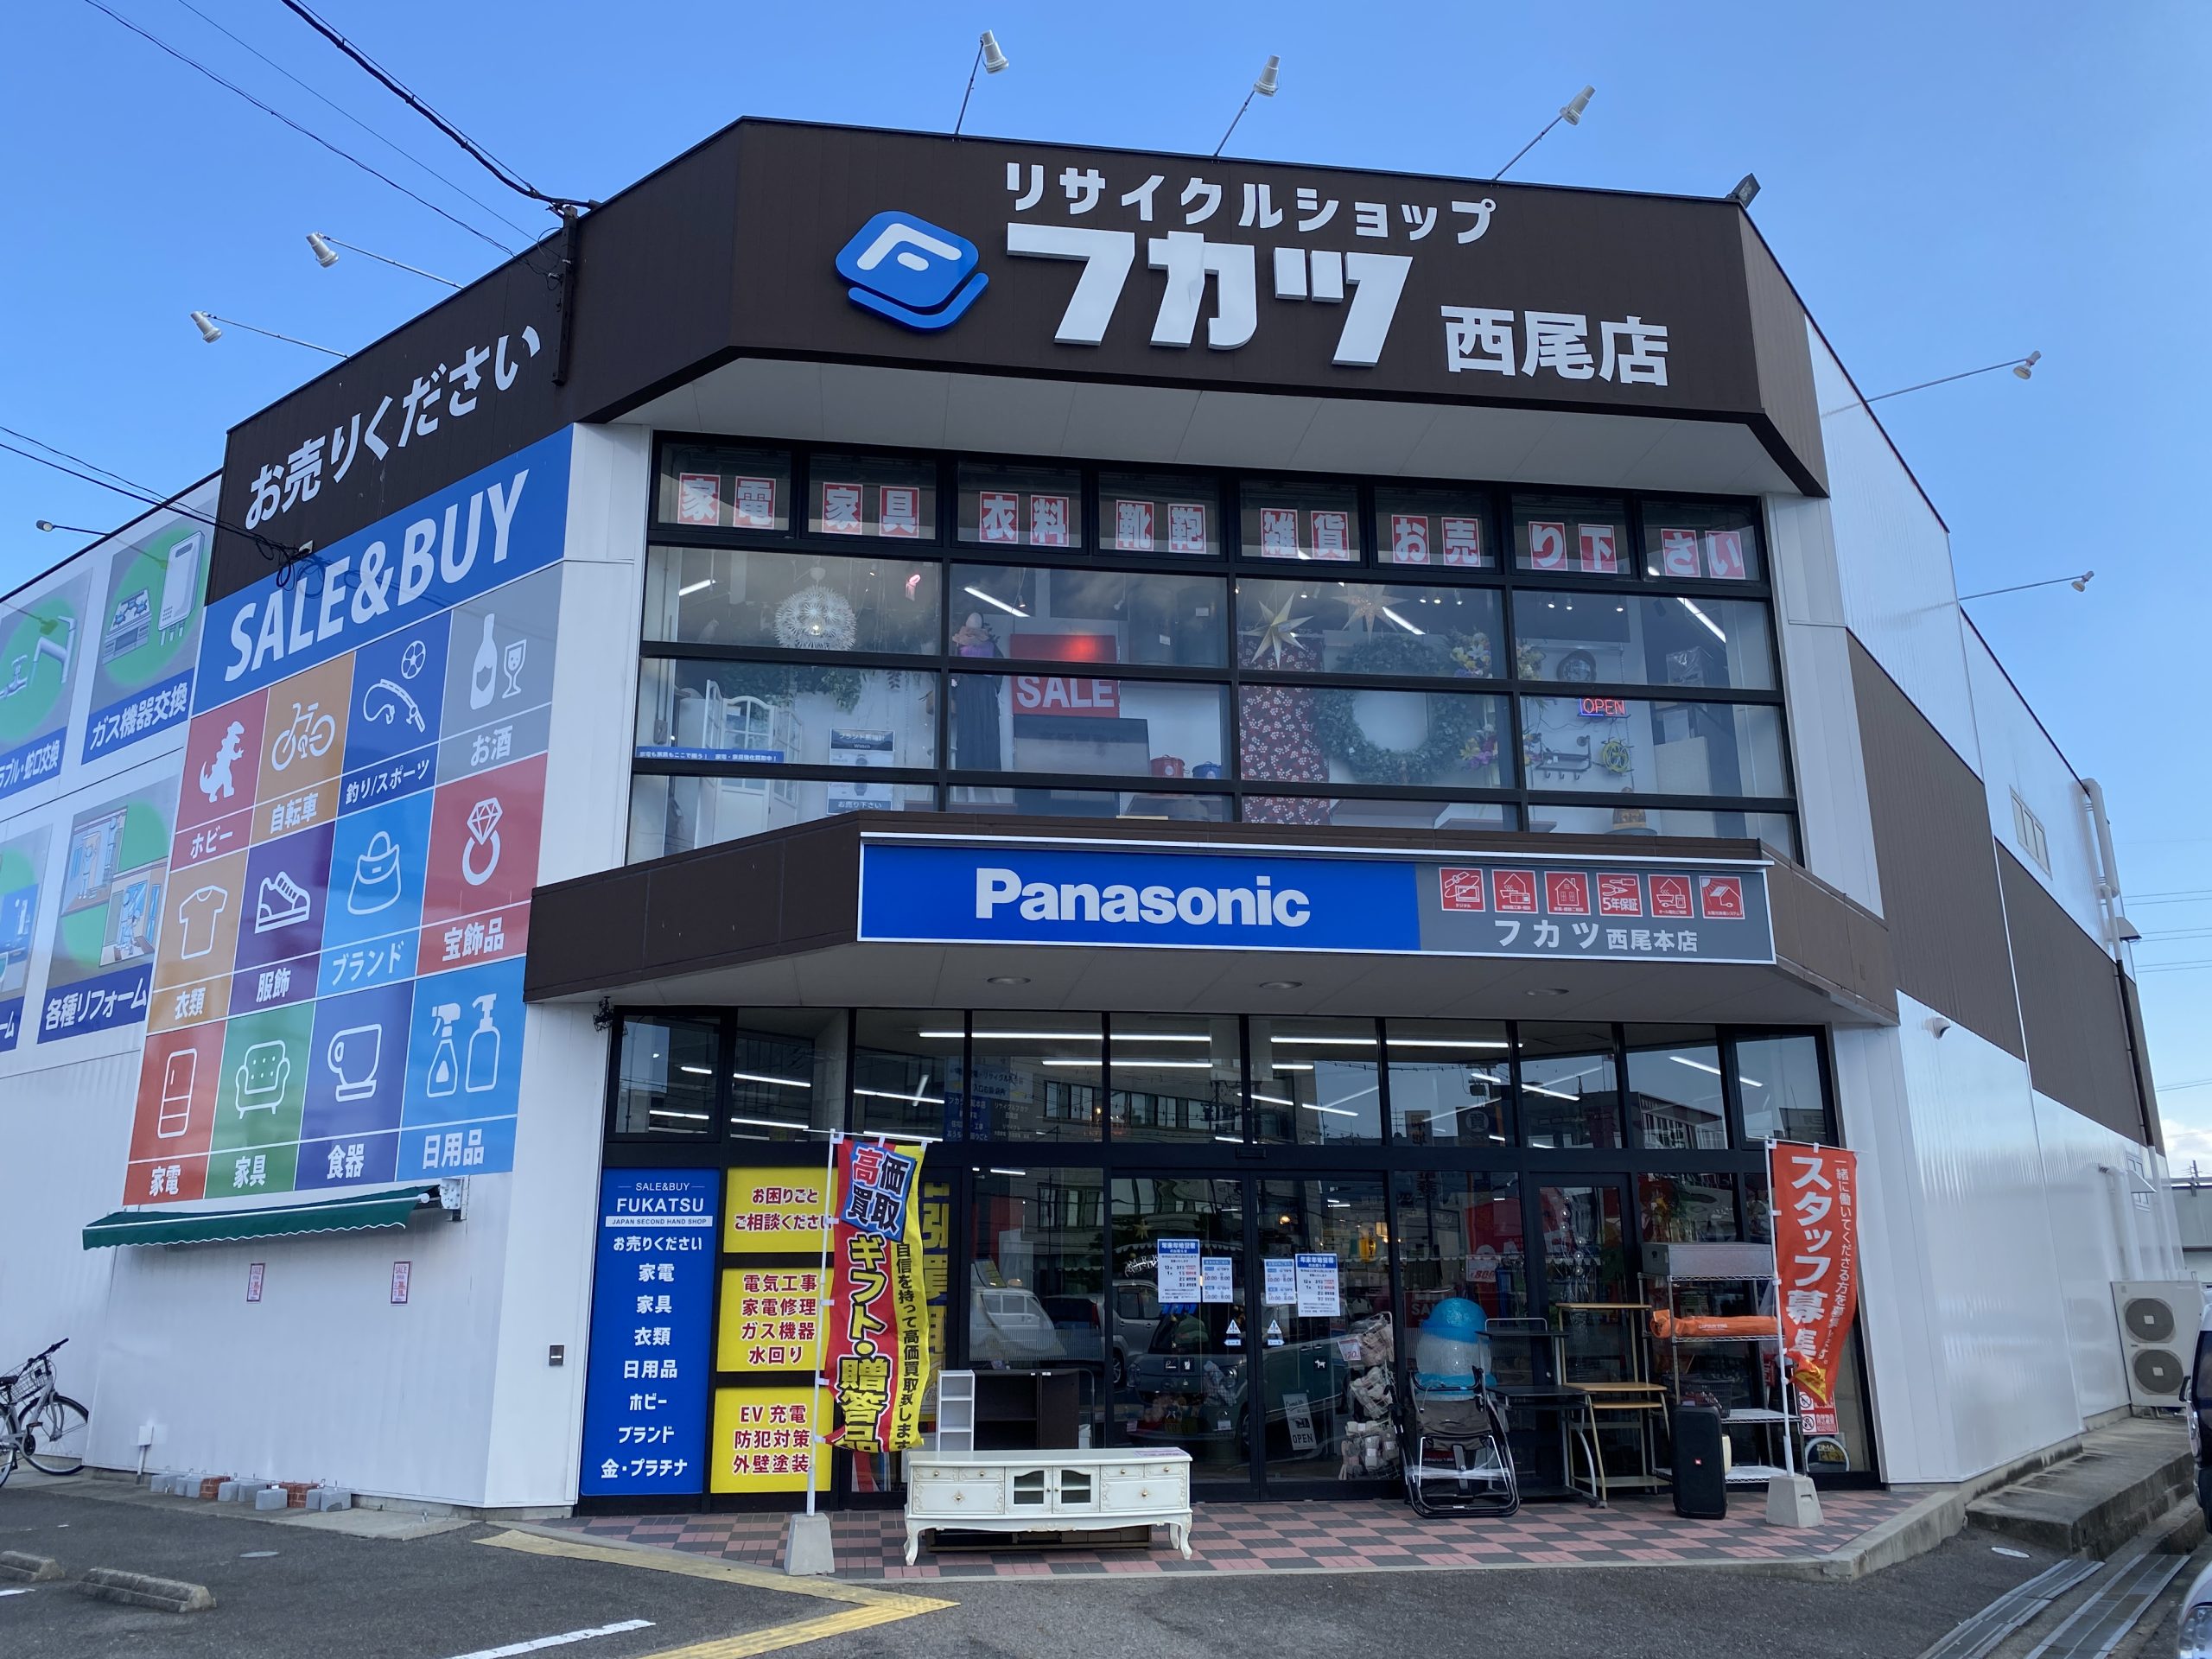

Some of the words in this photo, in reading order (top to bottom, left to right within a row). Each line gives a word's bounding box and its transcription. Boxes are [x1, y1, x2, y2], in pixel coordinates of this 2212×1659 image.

[1007, 162, 1497, 245] リサイクルショップ
[1006, 221, 1414, 368] フカツ
[1440, 304, 1669, 388] 西尾店
[245, 325, 540, 530] お売りください
[681, 476, 775, 527] 家電
[825, 484, 917, 534] 家具
[981, 493, 1067, 544] 衣料
[225, 468, 529, 682] SALE&BUY
[1016, 676, 1115, 709] SALE
[1583, 697, 1625, 715] OPEN
[90, 682, 188, 751] ガス機器交換
[471, 728, 512, 766] お酒
[346, 758, 429, 805] 釣り/スポーツ
[270, 792, 318, 835] 自転車
[189, 829, 234, 859] ホビー
[976, 867, 1311, 928] Panasonic
[1602, 897, 1639, 912] 5年保証
[442, 916, 505, 963] 宝飾品
[1494, 919, 1599, 950] フカツ
[1605, 927, 1698, 952] 西尾本店
[332, 940, 404, 986] ブランド
[256, 967, 291, 1002] 服飾
[45, 977, 147, 1031] 各種リフォーム
[174, 988, 205, 1020] 衣類
[327, 1143, 365, 1180] 食器
[422, 1128, 486, 1169] 日用品
[149, 1164, 181, 1197] 家電
[233, 1154, 267, 1188] 家具
[635, 1182, 690, 1192] SALE&BUY
[852, 1146, 912, 1197] 高価
[616, 1198, 704, 1213] FUKATSU
[751, 1187, 819, 1205] お困りごと
[846, 1183, 902, 1236] 買取
[734, 1212, 833, 1231] ご相談ください
[613, 1236, 702, 1252] お売りください
[638, 1262, 675, 1283] 家電
[743, 1274, 817, 1293] 電気工事
[636, 1294, 672, 1314] 家具
[741, 1298, 817, 1317] 家電修理
[634, 1326, 671, 1346] 衣類
[741, 1322, 815, 1340] ガス機器
[623, 1360, 678, 1380] 日用品
[748, 1346, 802, 1365] 水回り
[629, 1393, 667, 1411] ホビー
[741, 1406, 764, 1423] EV
[770, 1405, 806, 1424] 充電
[618, 1426, 675, 1444] ブランド
[734, 1429, 810, 1449] 防犯対策
[1292, 1433, 1314, 1444] OPEN
[601, 1458, 688, 1479] 金・プラチナ
[733, 1454, 809, 1474] 外壁塗装
